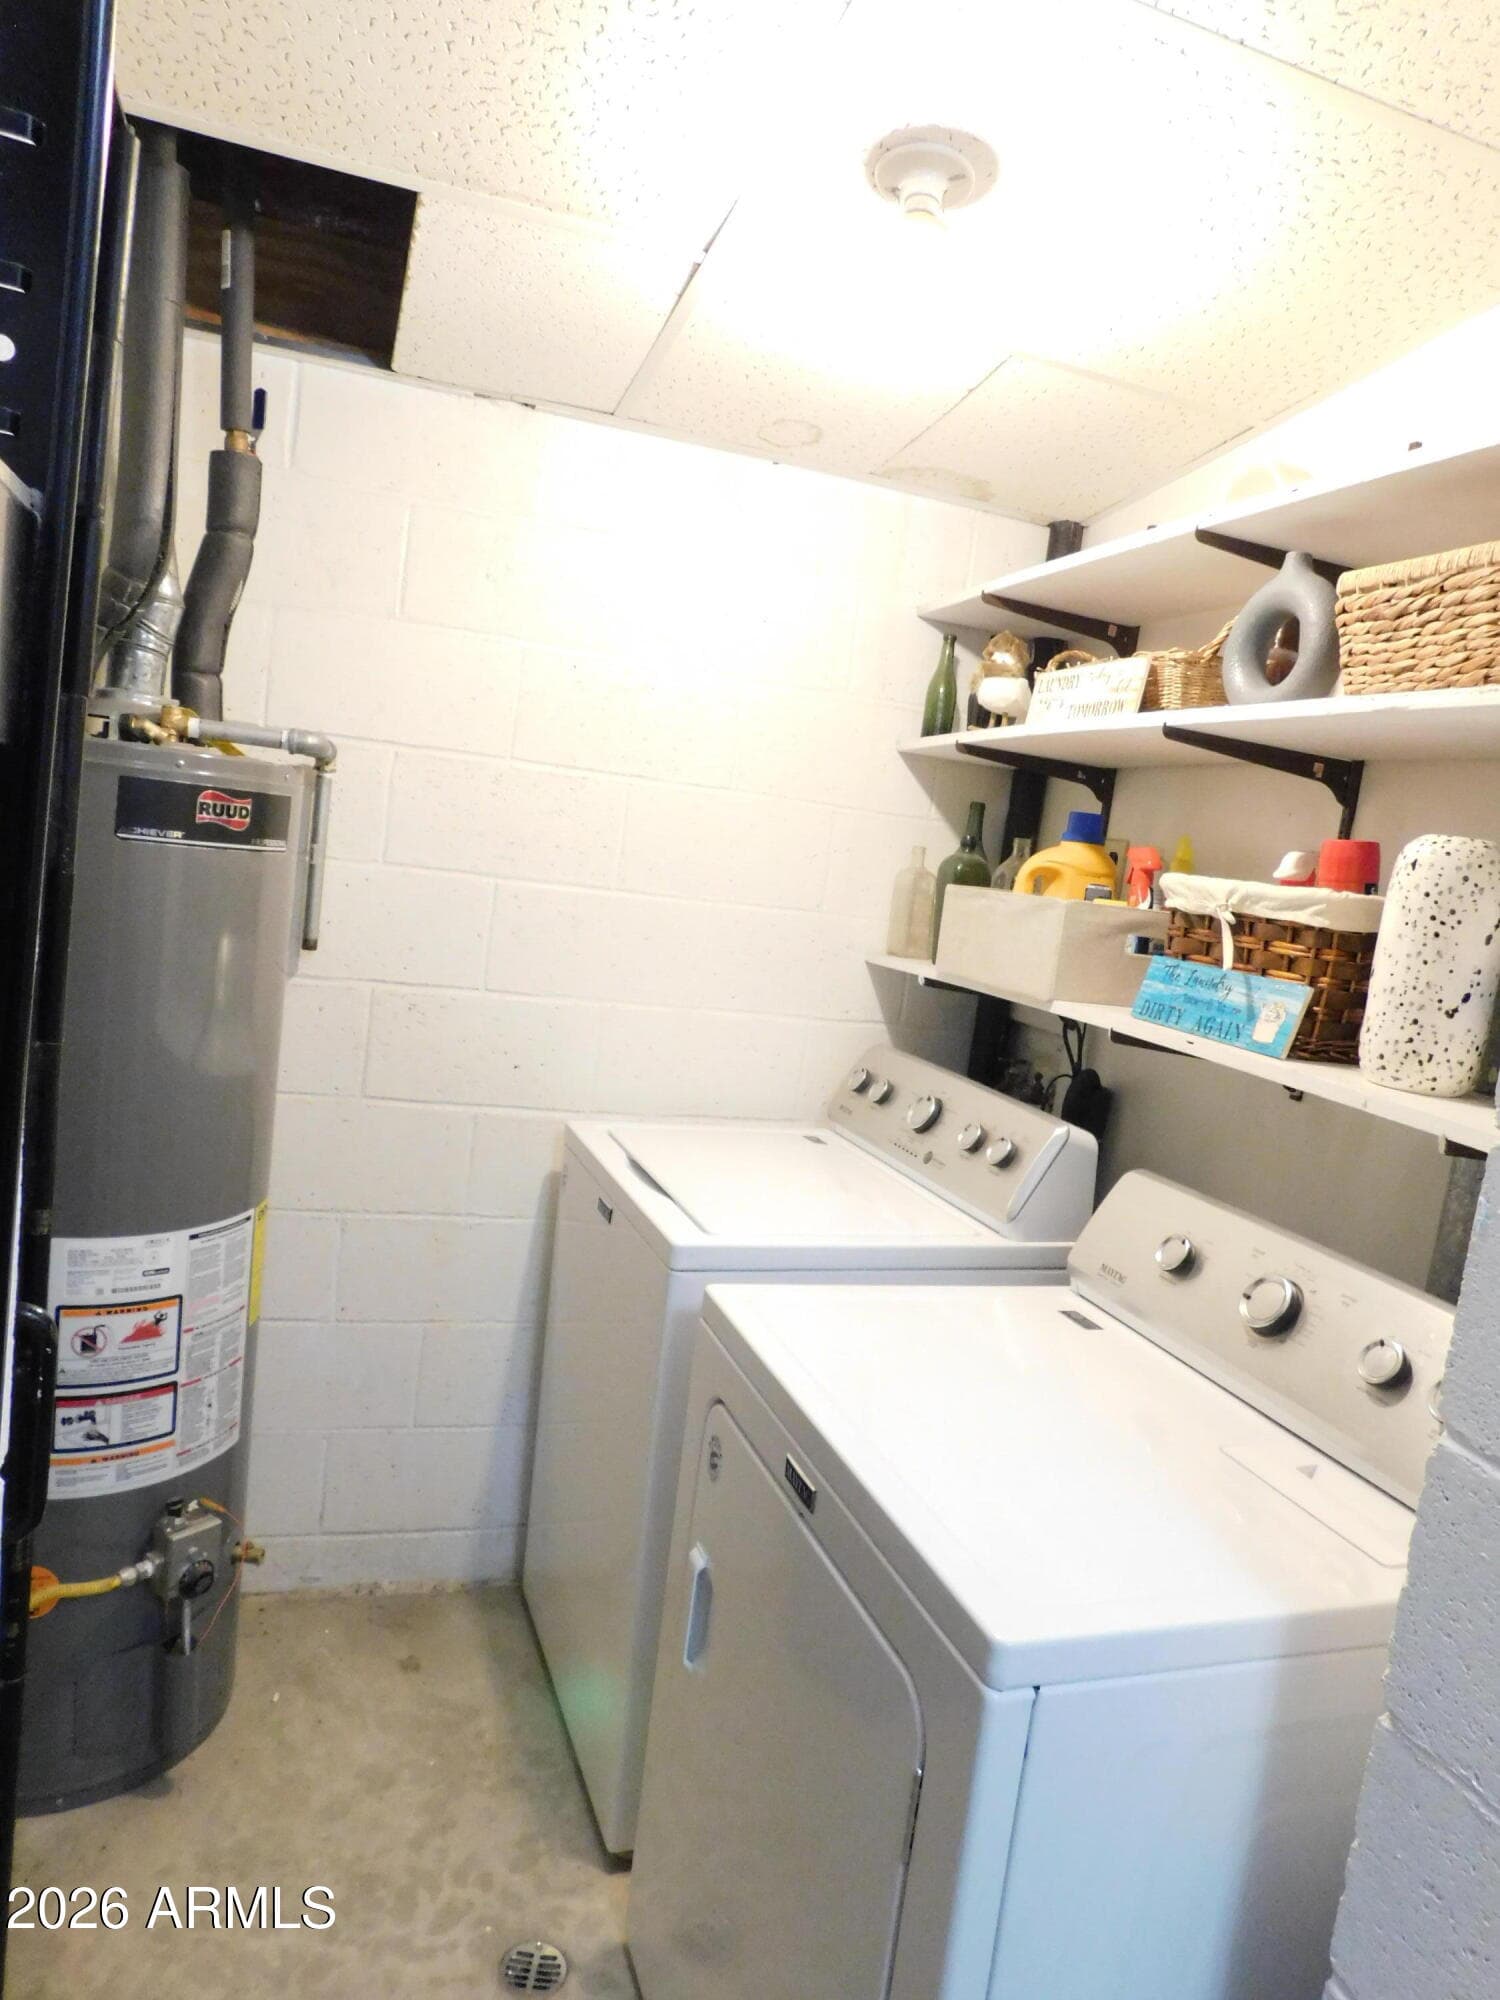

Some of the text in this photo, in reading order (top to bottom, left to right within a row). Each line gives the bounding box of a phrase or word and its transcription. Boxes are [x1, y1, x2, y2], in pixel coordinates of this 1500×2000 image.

[1067, 698, 1125, 720] TOMORROW
[199, 802, 250, 819] RUUD
[1164, 964, 1181, 982] The
[1138, 999, 1186, 1026] DIRTY
[1191, 1015, 1246, 1041] AGAIN
[106, 1306, 149, 1315] WARNING
